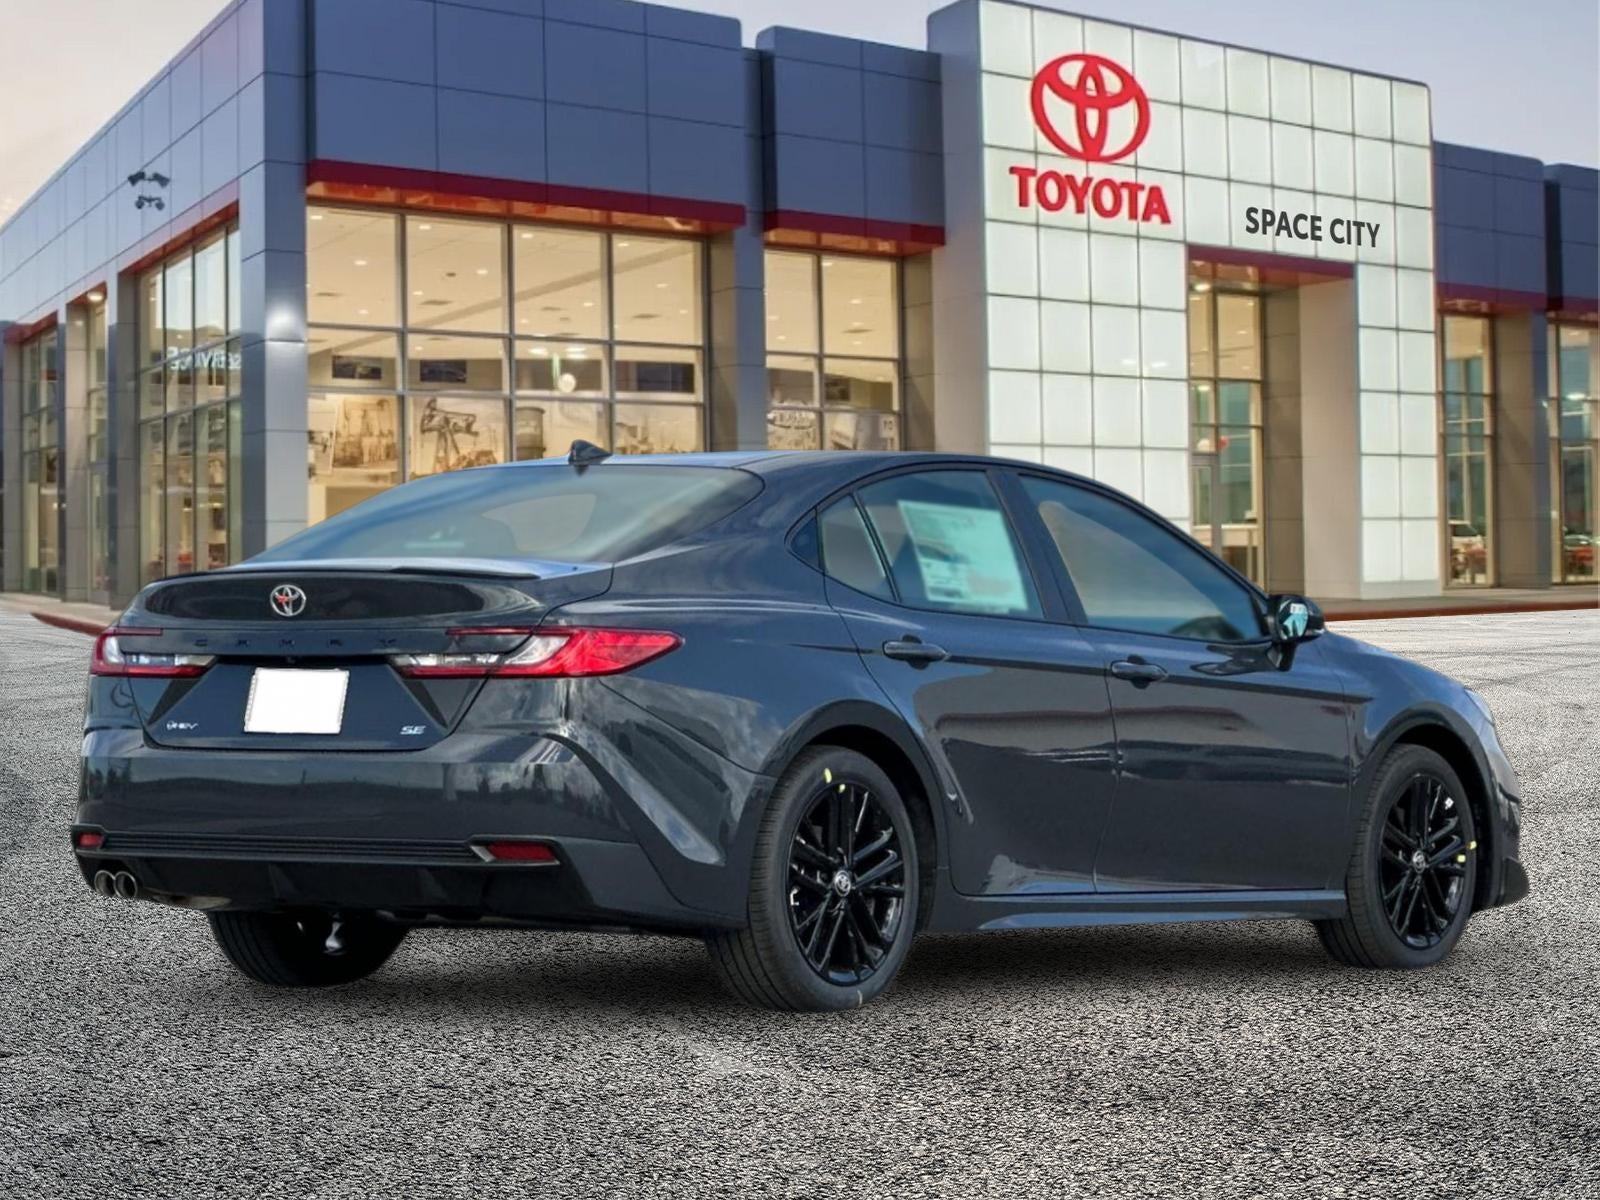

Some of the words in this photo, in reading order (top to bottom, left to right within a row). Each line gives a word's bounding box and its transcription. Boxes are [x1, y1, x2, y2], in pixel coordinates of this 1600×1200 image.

[1009, 166, 1171, 224] TOYOTA
[1245, 206, 1323, 241] SPACE
[1329, 218, 1381, 248] CITY
[400, 725, 426, 735] SE
